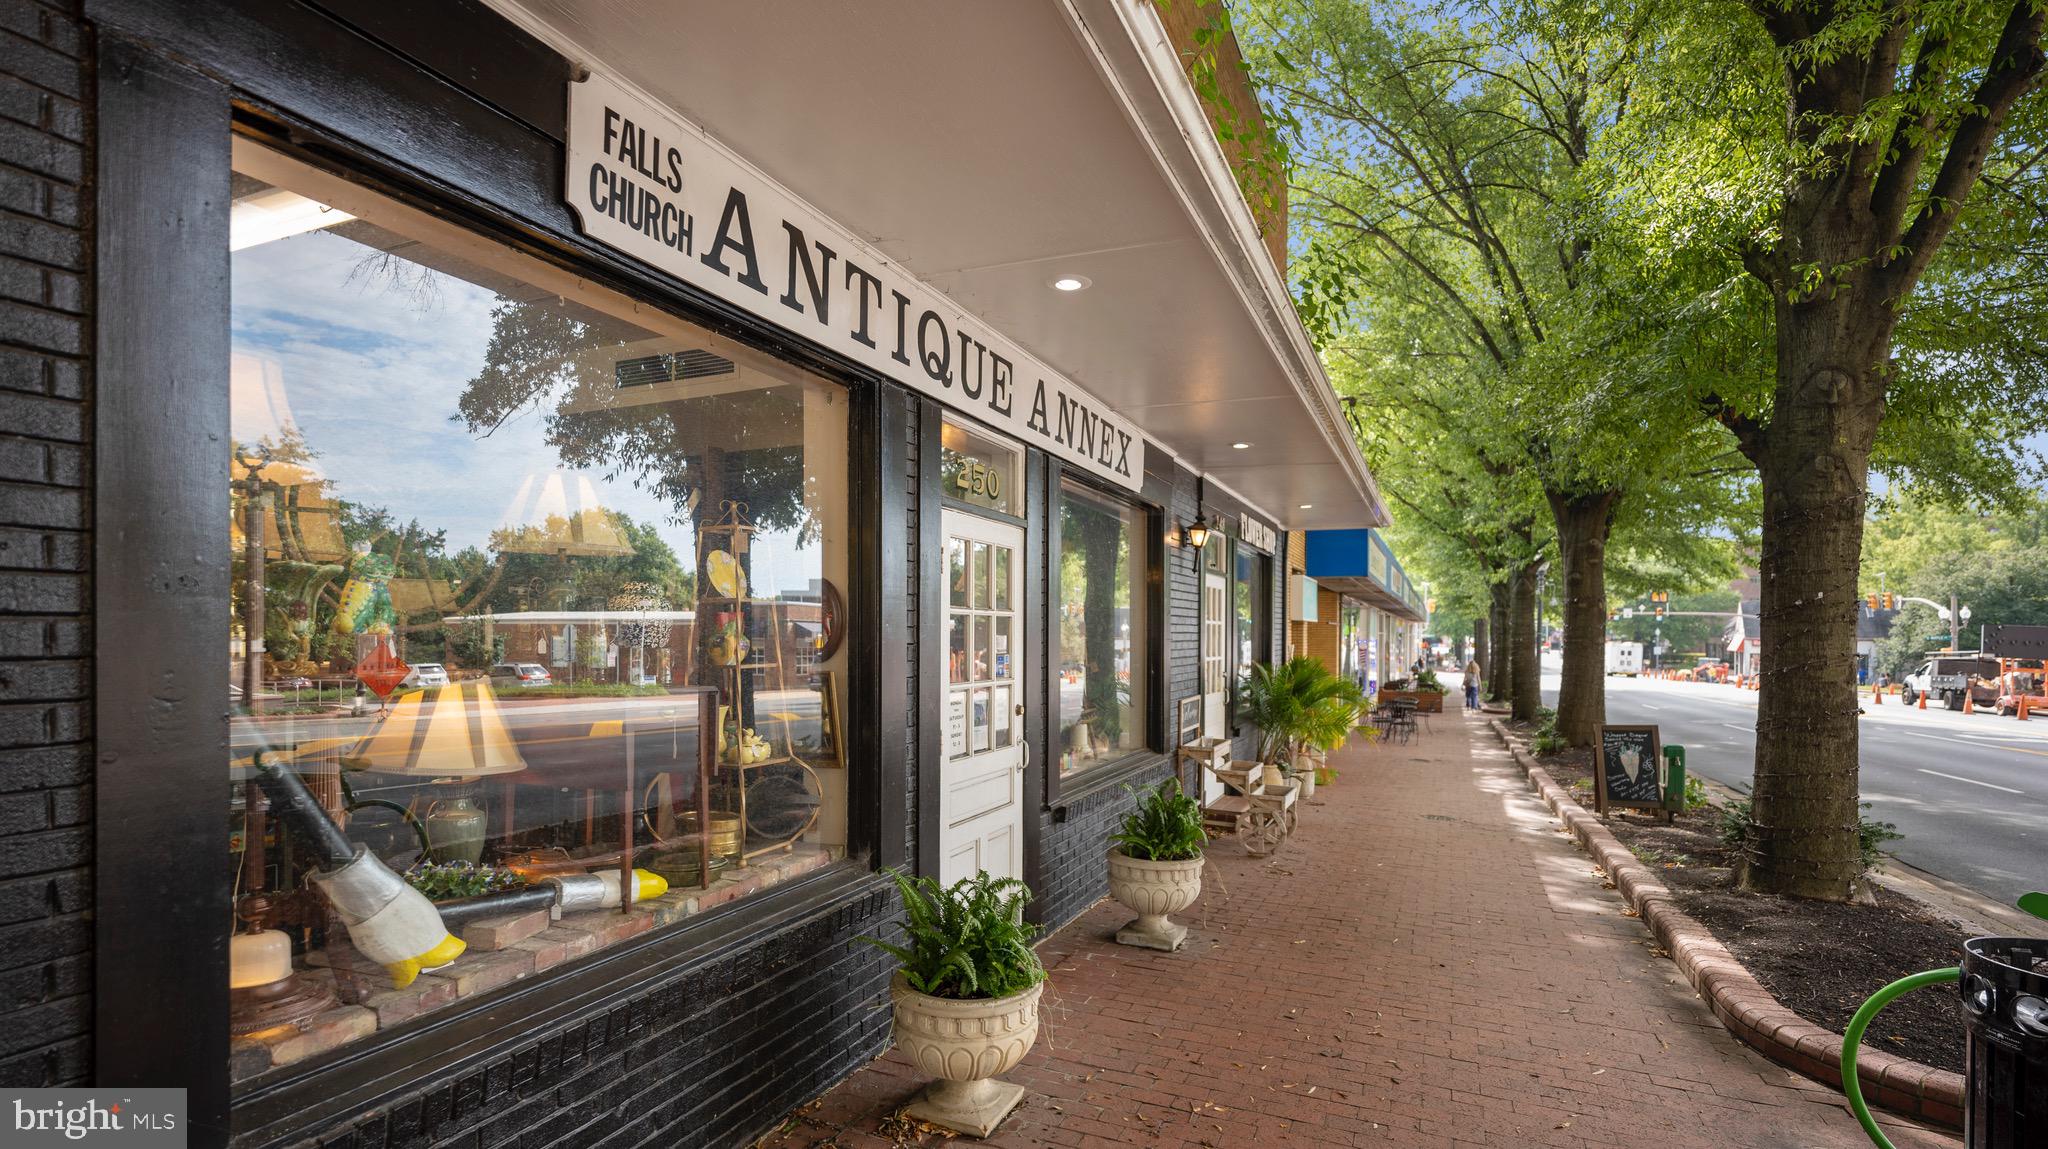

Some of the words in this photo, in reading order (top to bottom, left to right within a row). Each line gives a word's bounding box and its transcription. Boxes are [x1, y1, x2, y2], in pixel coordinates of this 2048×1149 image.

[603, 105, 683, 194] FALLS
[589, 162, 693, 258] CHURCH
[700, 186, 1013, 418] ANTIQUE
[1026, 379, 1132, 478] ANNEX
[956, 457, 999, 499] 250
